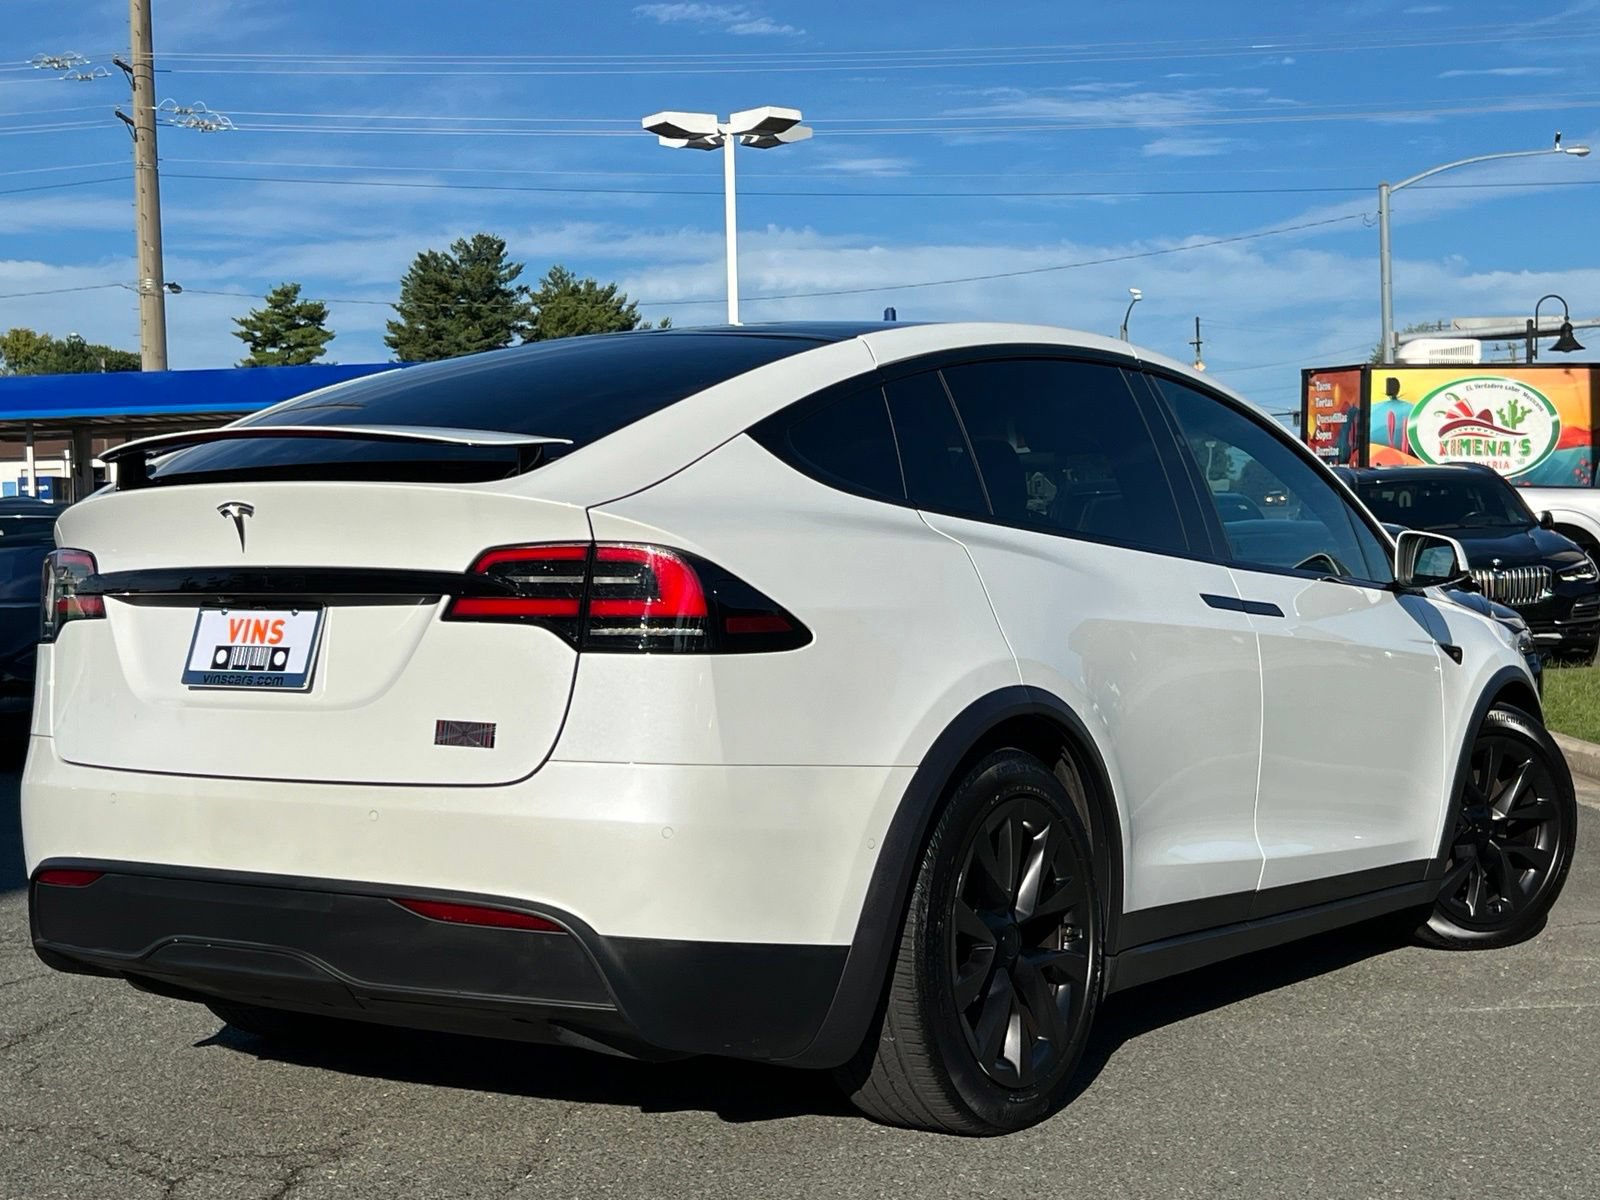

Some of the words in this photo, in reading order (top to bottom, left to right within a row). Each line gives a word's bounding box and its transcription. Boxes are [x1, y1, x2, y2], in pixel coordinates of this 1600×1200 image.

[1315, 397, 1333, 407] Tortas
[1315, 429, 1332, 442] Sopes
[1439, 438, 1532, 456] XIMENA'S
[229, 618, 286, 645] VINS
[203, 675, 285, 686] vinscars.com
